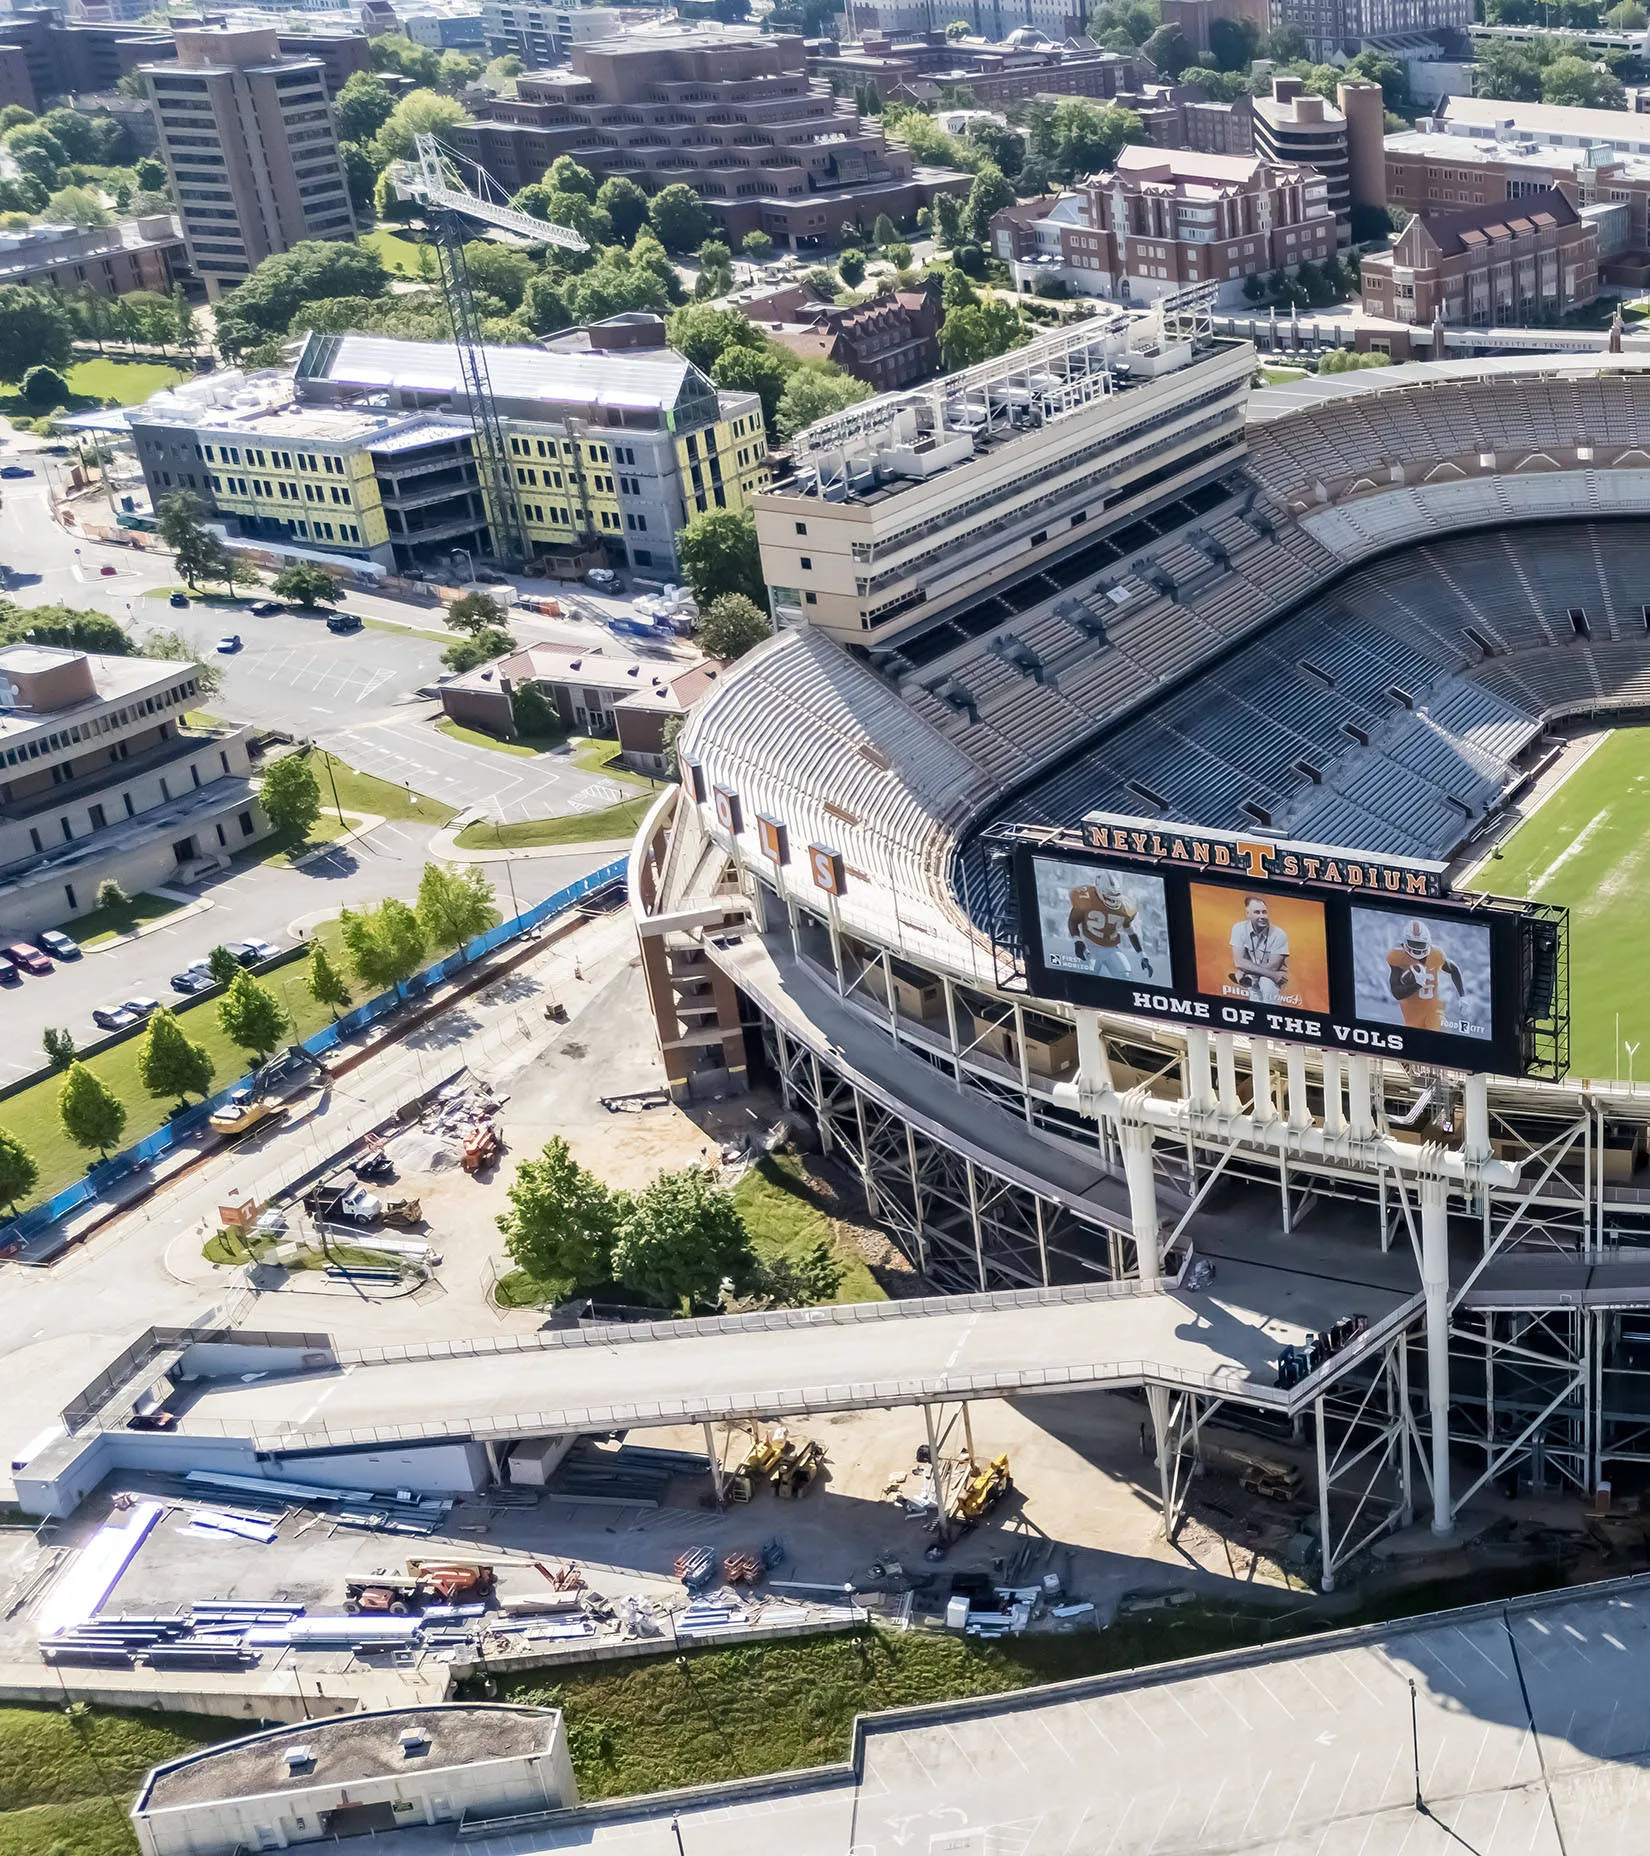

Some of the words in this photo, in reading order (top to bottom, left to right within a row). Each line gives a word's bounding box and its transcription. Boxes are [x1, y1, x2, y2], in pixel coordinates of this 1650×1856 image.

[1471, 340, 1526, 348] UNIVERSITY
[1543, 342, 1592, 350] TENNESSEE
[716, 792, 731, 828] O
[760, 821, 778, 861] L
[815, 853, 833, 889] S
[1091, 826, 1230, 866] NEYLAND
[1283, 855, 1427, 896] STADIUM
[1086, 910, 1125, 940] 27
[1132, 991, 1210, 1019] HOME
[1221, 1006, 1255, 1025] OF
[1266, 1014, 1321, 1037] THE
[1333, 1024, 1404, 1051] VOLS
[1440, 1020, 1459, 1029] FOOD
[1470, 1024, 1486, 1033] CITY
